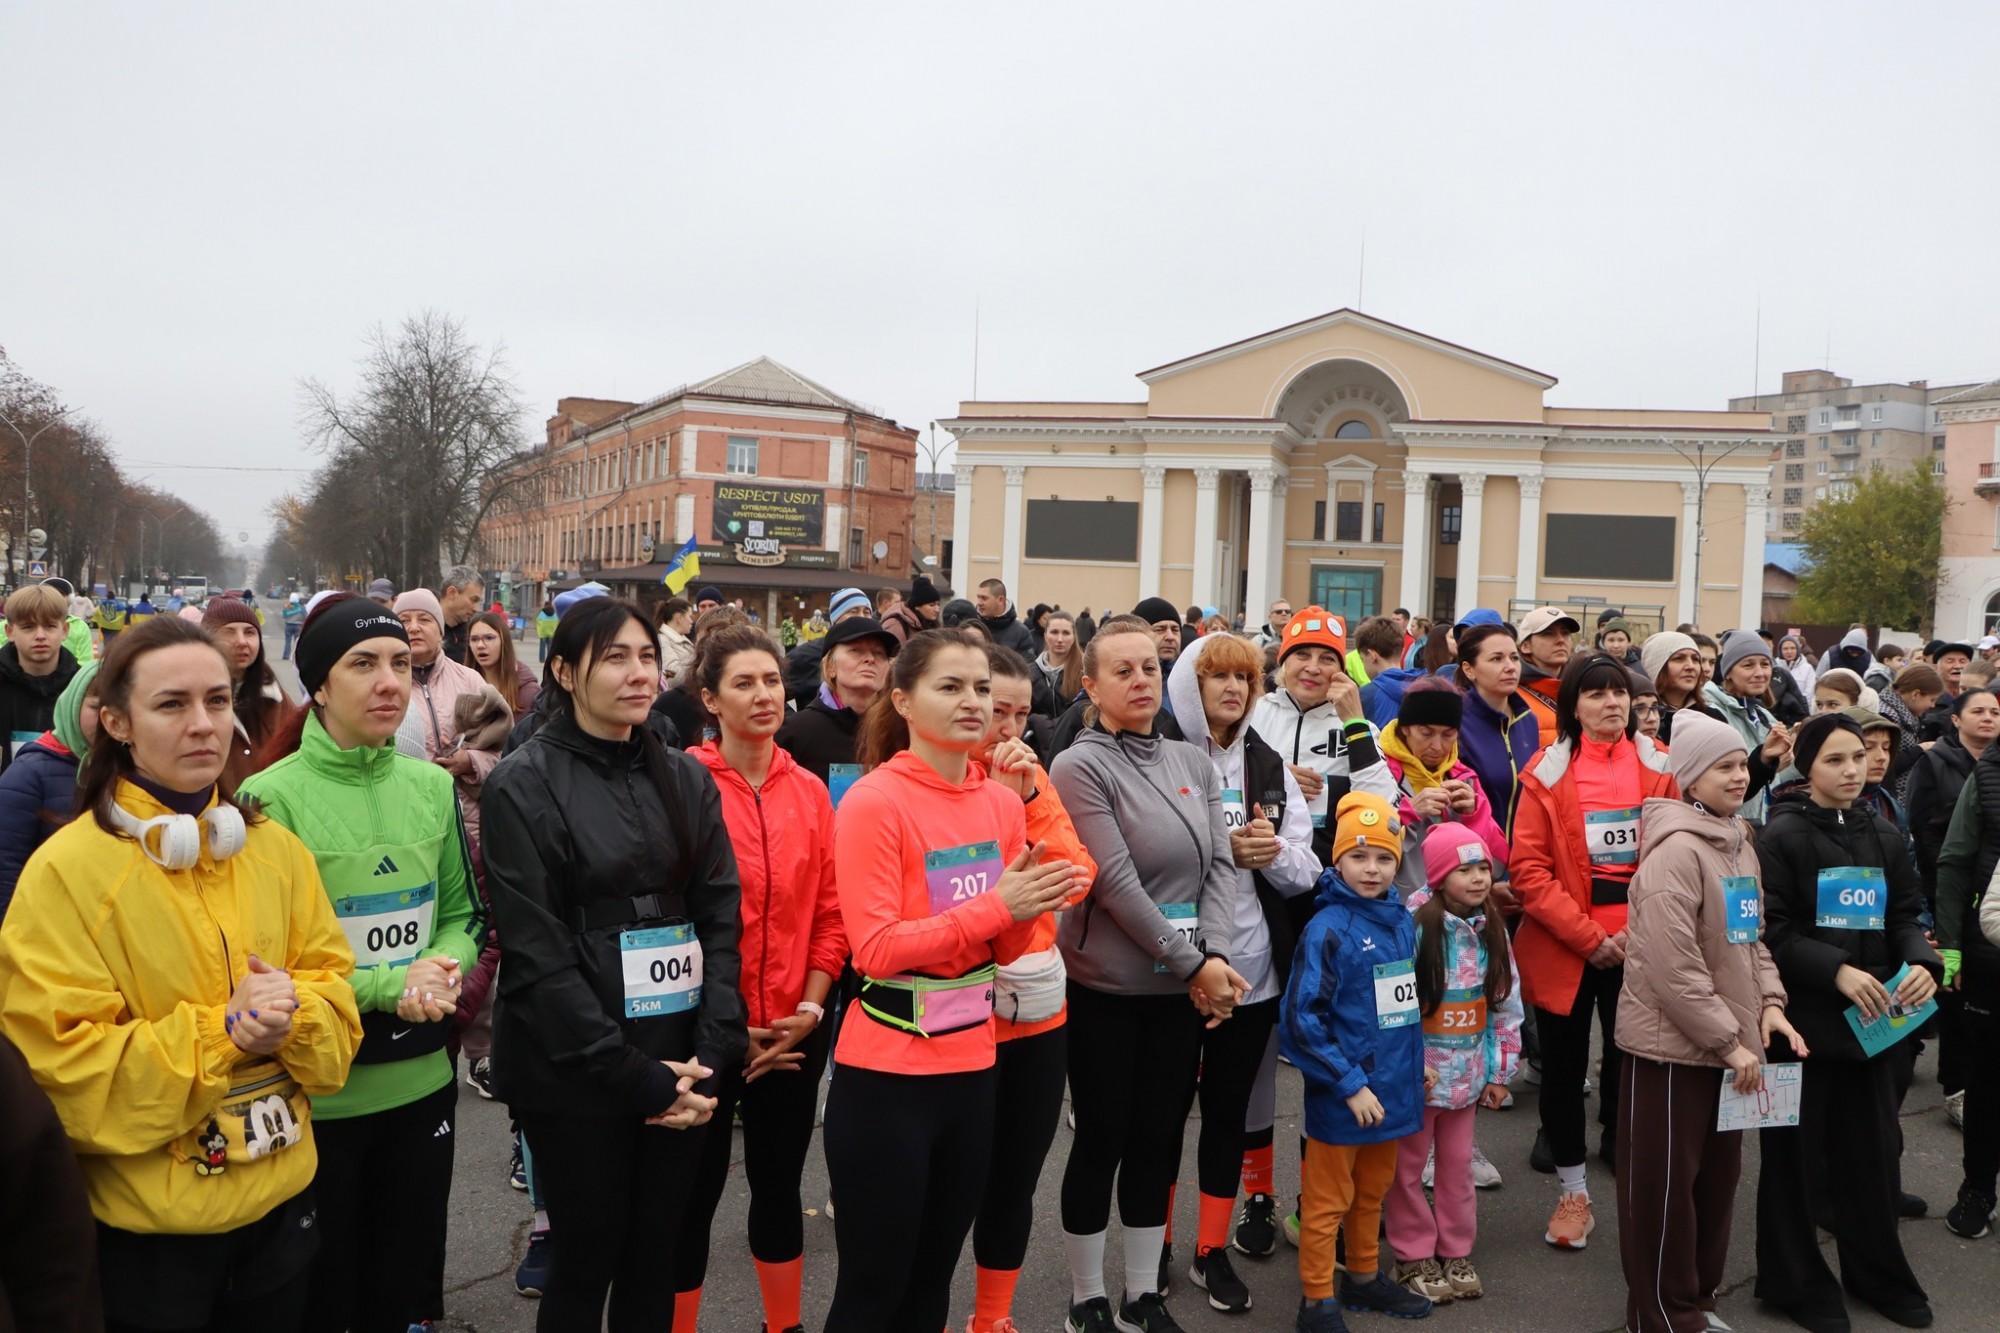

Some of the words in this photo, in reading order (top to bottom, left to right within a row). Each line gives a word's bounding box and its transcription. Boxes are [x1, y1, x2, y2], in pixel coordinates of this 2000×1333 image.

[719, 487, 780, 502] RESPECT
[783, 493, 820, 505] USDT
[1604, 827, 1636, 846] 031
[950, 872, 987, 900] 207
[1839, 888, 1876, 906] 600
[367, 921, 418, 952] 008
[650, 955, 692, 983] 004
[1443, 1009, 1477, 1027] 522
